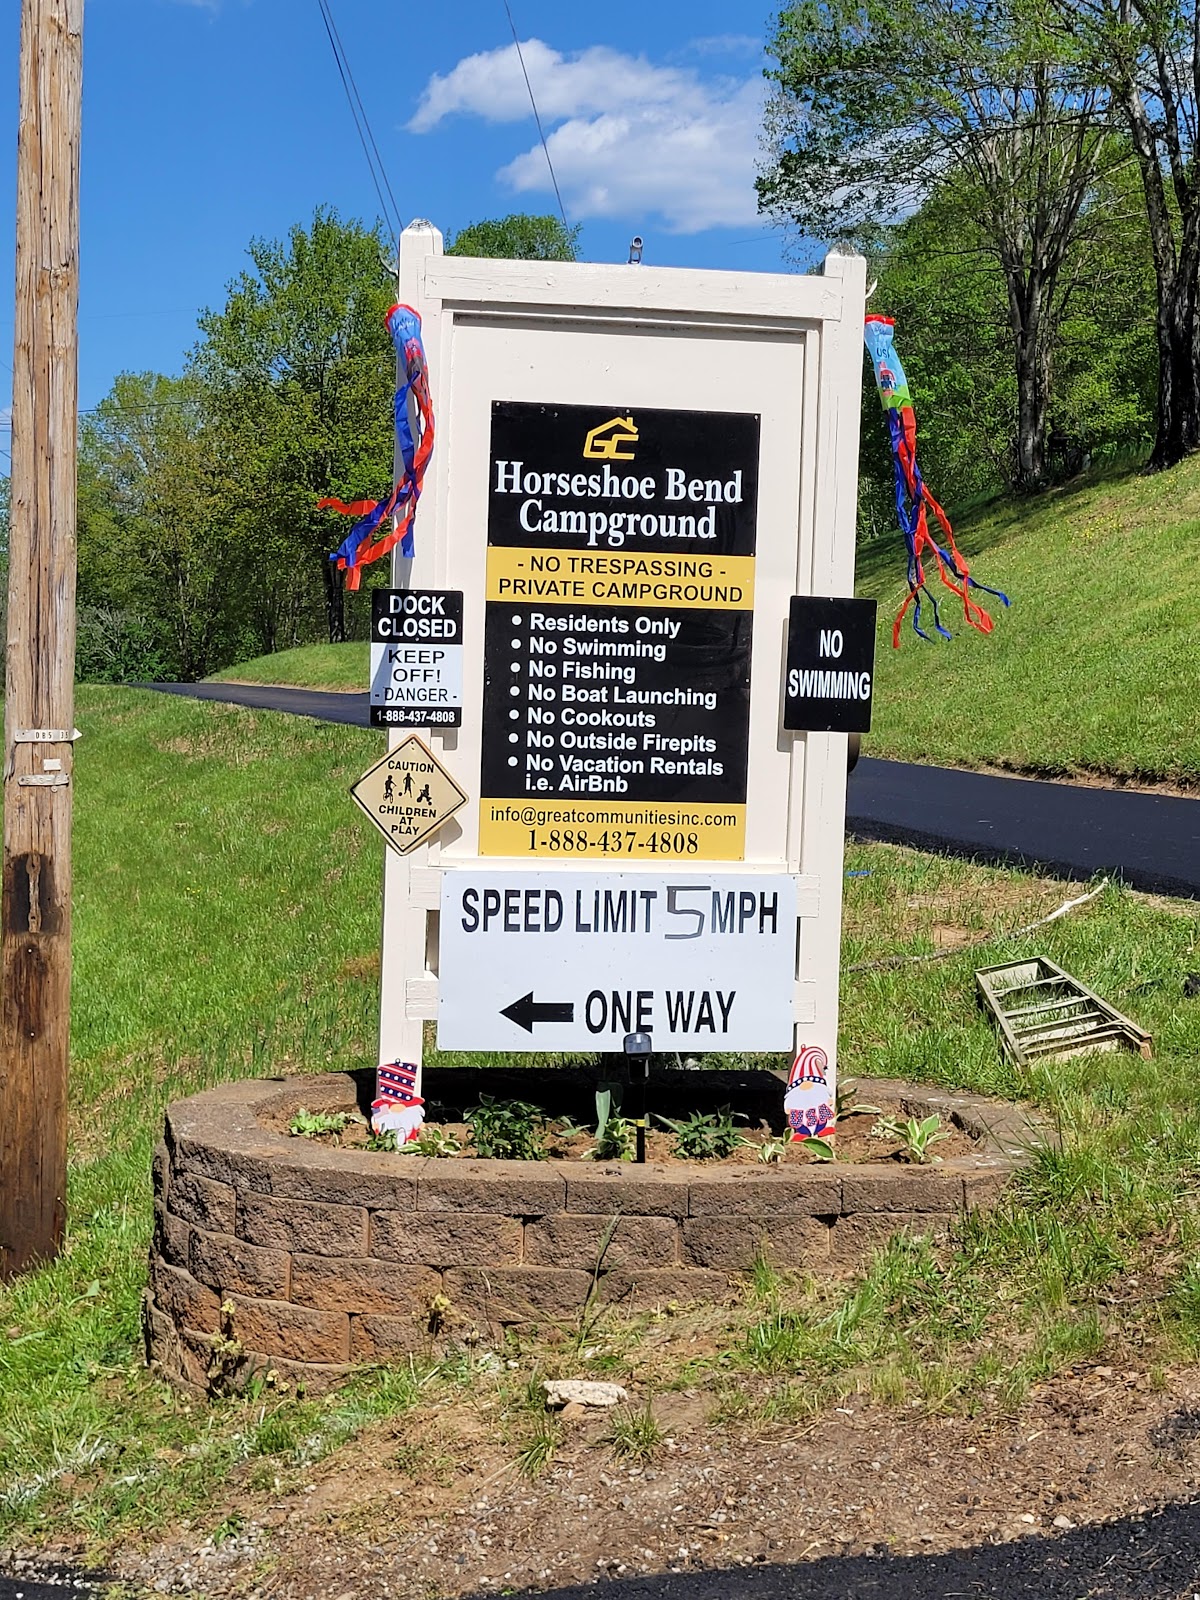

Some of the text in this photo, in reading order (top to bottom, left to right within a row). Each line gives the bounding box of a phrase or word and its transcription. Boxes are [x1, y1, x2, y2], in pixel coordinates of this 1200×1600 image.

[494, 461, 743, 503] Horseshoe Bend
[520, 499, 717, 546] Campground
[530, 556, 560, 572] NO
[568, 558, 713, 577] TRESPASSING
[499, 579, 743, 602] PRIVATE CAMPGROUND
[390, 595, 445, 615] DOCK
[378, 618, 456, 638] CLOSED
[530, 613, 681, 638] Residents Only
[529, 637, 666, 661] No Swimming
[820, 629, 843, 658] NO
[388, 650, 445, 664] KEEP
[393, 669, 441, 683] OFF!
[529, 660, 636, 684] No Fishing
[384, 687, 448, 702] DANGER
[788, 669, 870, 700] SWIMMING
[528, 684, 717, 709] No Boat Launching
[377, 710, 455, 723] 1-888-437-4808
[527, 708, 656, 727] No Cookouts
[526, 731, 717, 755] No Outside Firepits
[388, 760, 434, 773] CAUTION
[526, 754, 724, 776] No Vacation Rentals
[526, 774, 628, 793] i.e. AirBnb
[379, 804, 437, 818] CHILDREN
[400, 816, 414, 826] AT
[491, 806, 736, 827] info@greatcommunitiesinc.com
[391, 825, 420, 836] PLAY
[528, 829, 699, 854] 1-888-437-4808
[461, 886, 778, 940] SPEED LIMIT 5 MPH
[585, 990, 736, 1034] ONE WAY
[789, 1103, 835, 1128] USA
